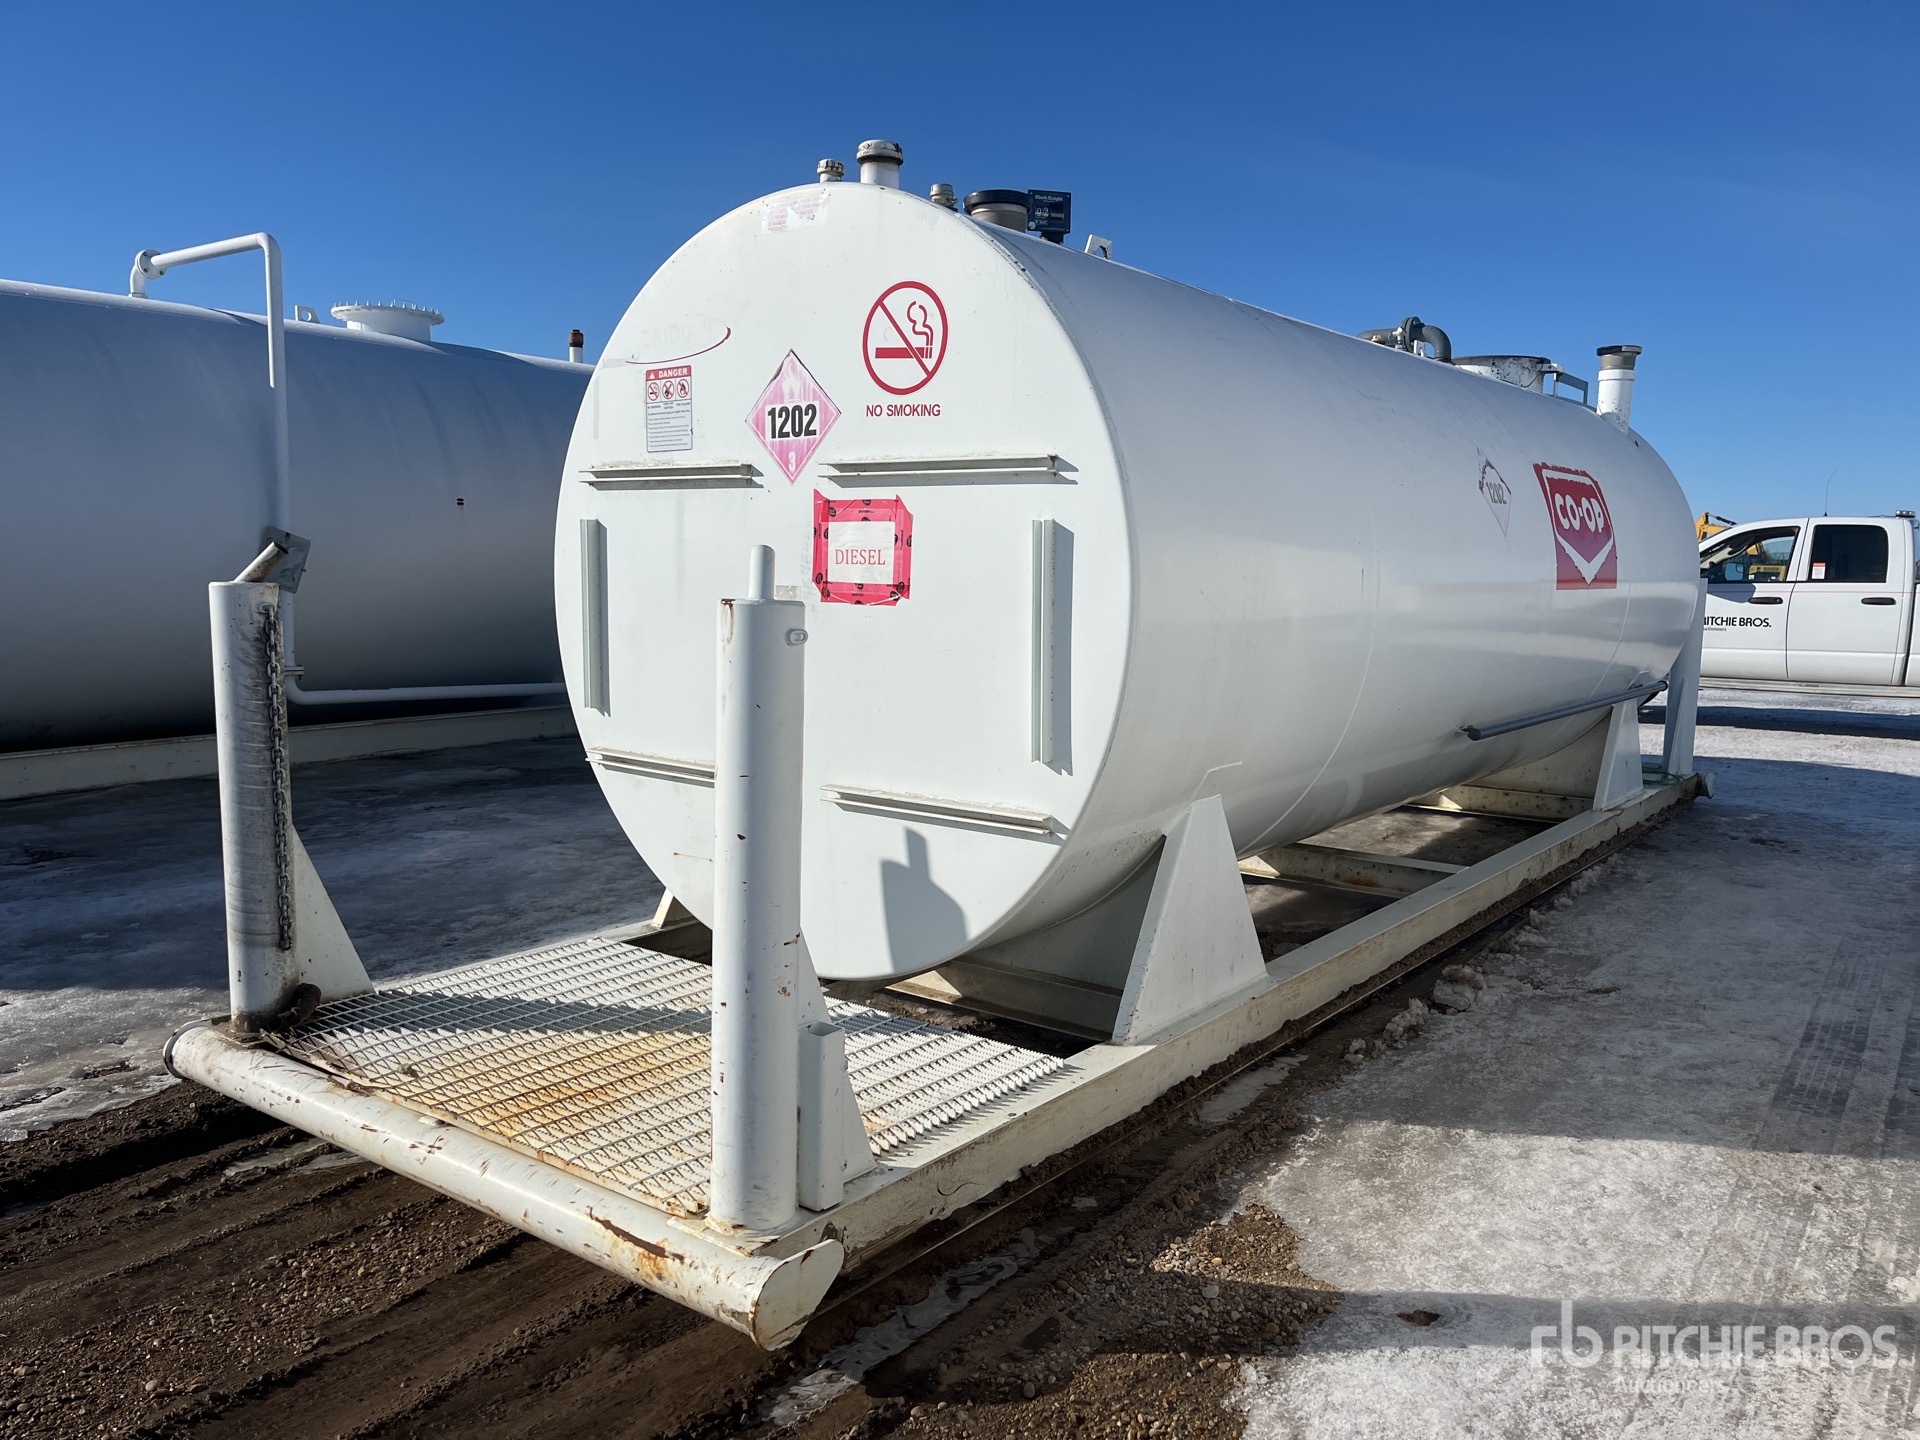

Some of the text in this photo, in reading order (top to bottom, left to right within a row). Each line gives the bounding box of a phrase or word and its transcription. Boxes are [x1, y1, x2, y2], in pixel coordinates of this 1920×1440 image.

[658, 368, 688, 378] DANGER
[866, 404, 941, 417] NO SMOKING
[767, 404, 818, 439] 1202
[788, 451, 797, 473] 3
[1486, 482, 1507, 504] 1202
[1554, 492, 1604, 533] CO-OP
[835, 549, 886, 566] DIESEL
[1739, 617, 1772, 628] BROS.
